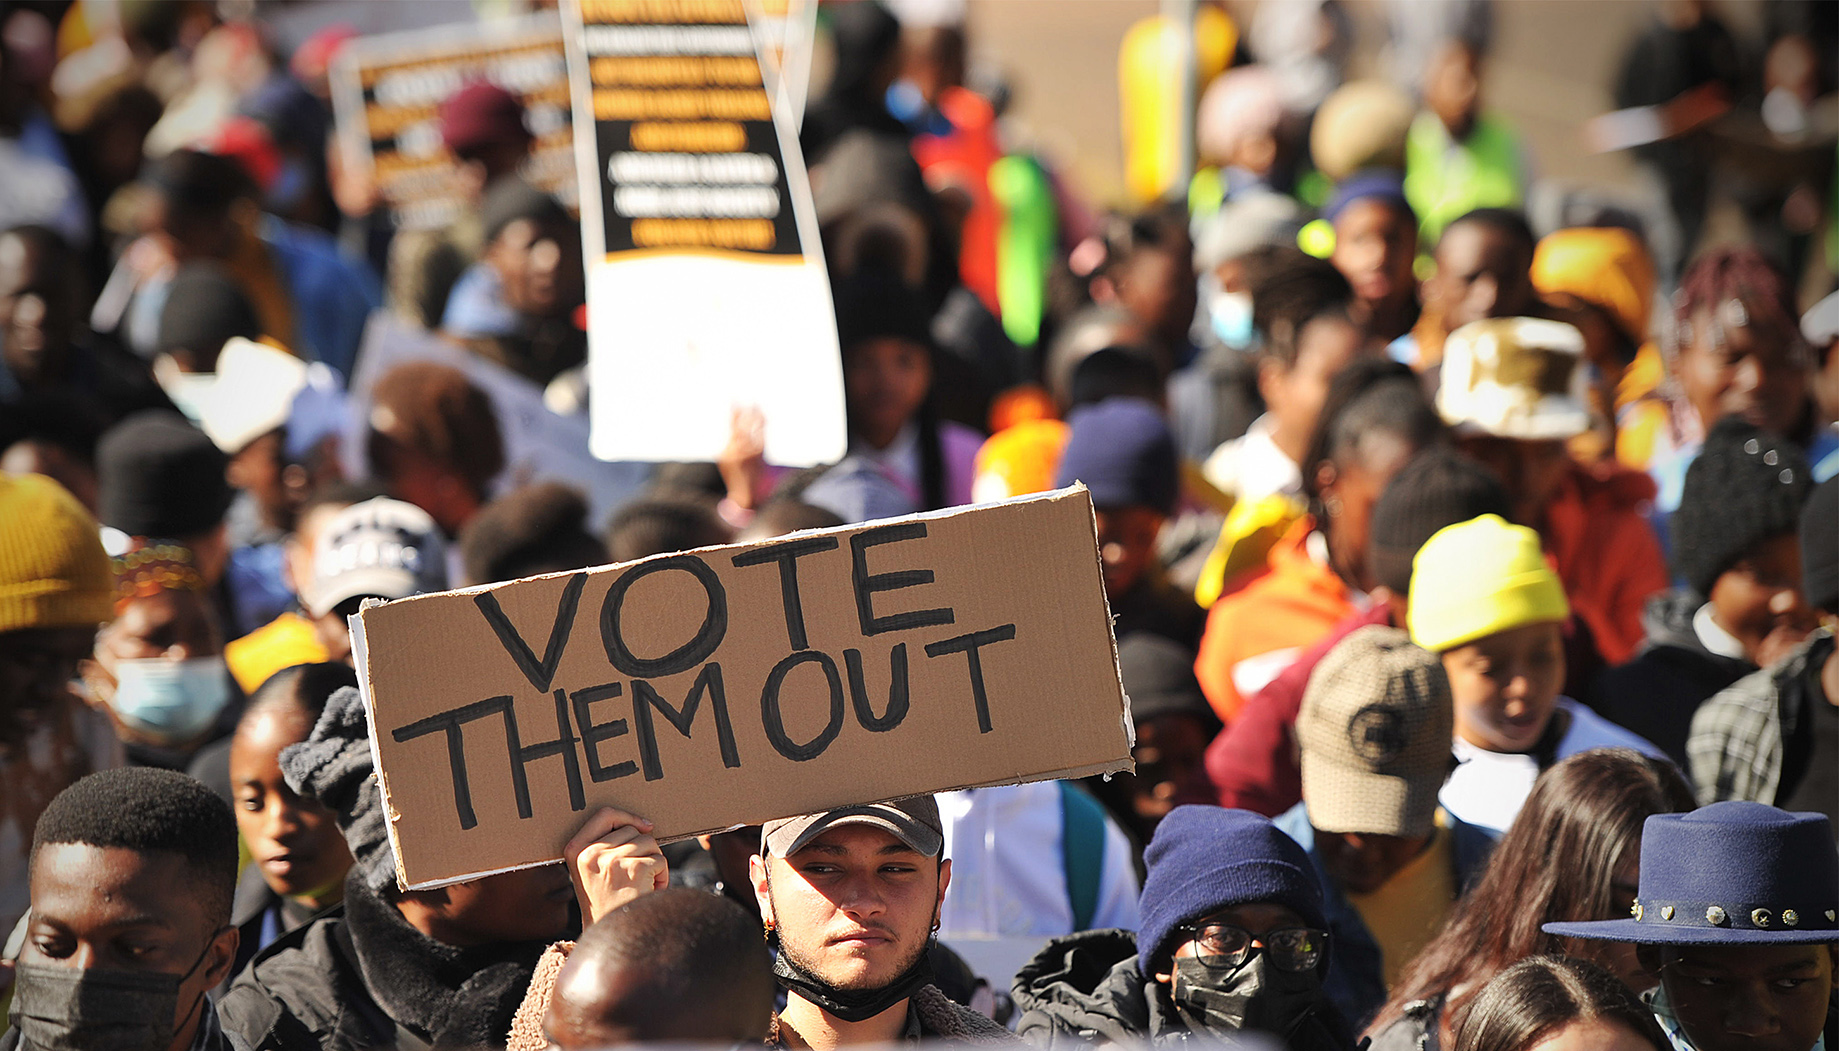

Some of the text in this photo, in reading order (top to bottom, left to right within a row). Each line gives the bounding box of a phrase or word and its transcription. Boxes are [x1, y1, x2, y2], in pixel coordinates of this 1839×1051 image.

[474, 522, 954, 693] VOTE
[392, 624, 1016, 830] THEM OUT
